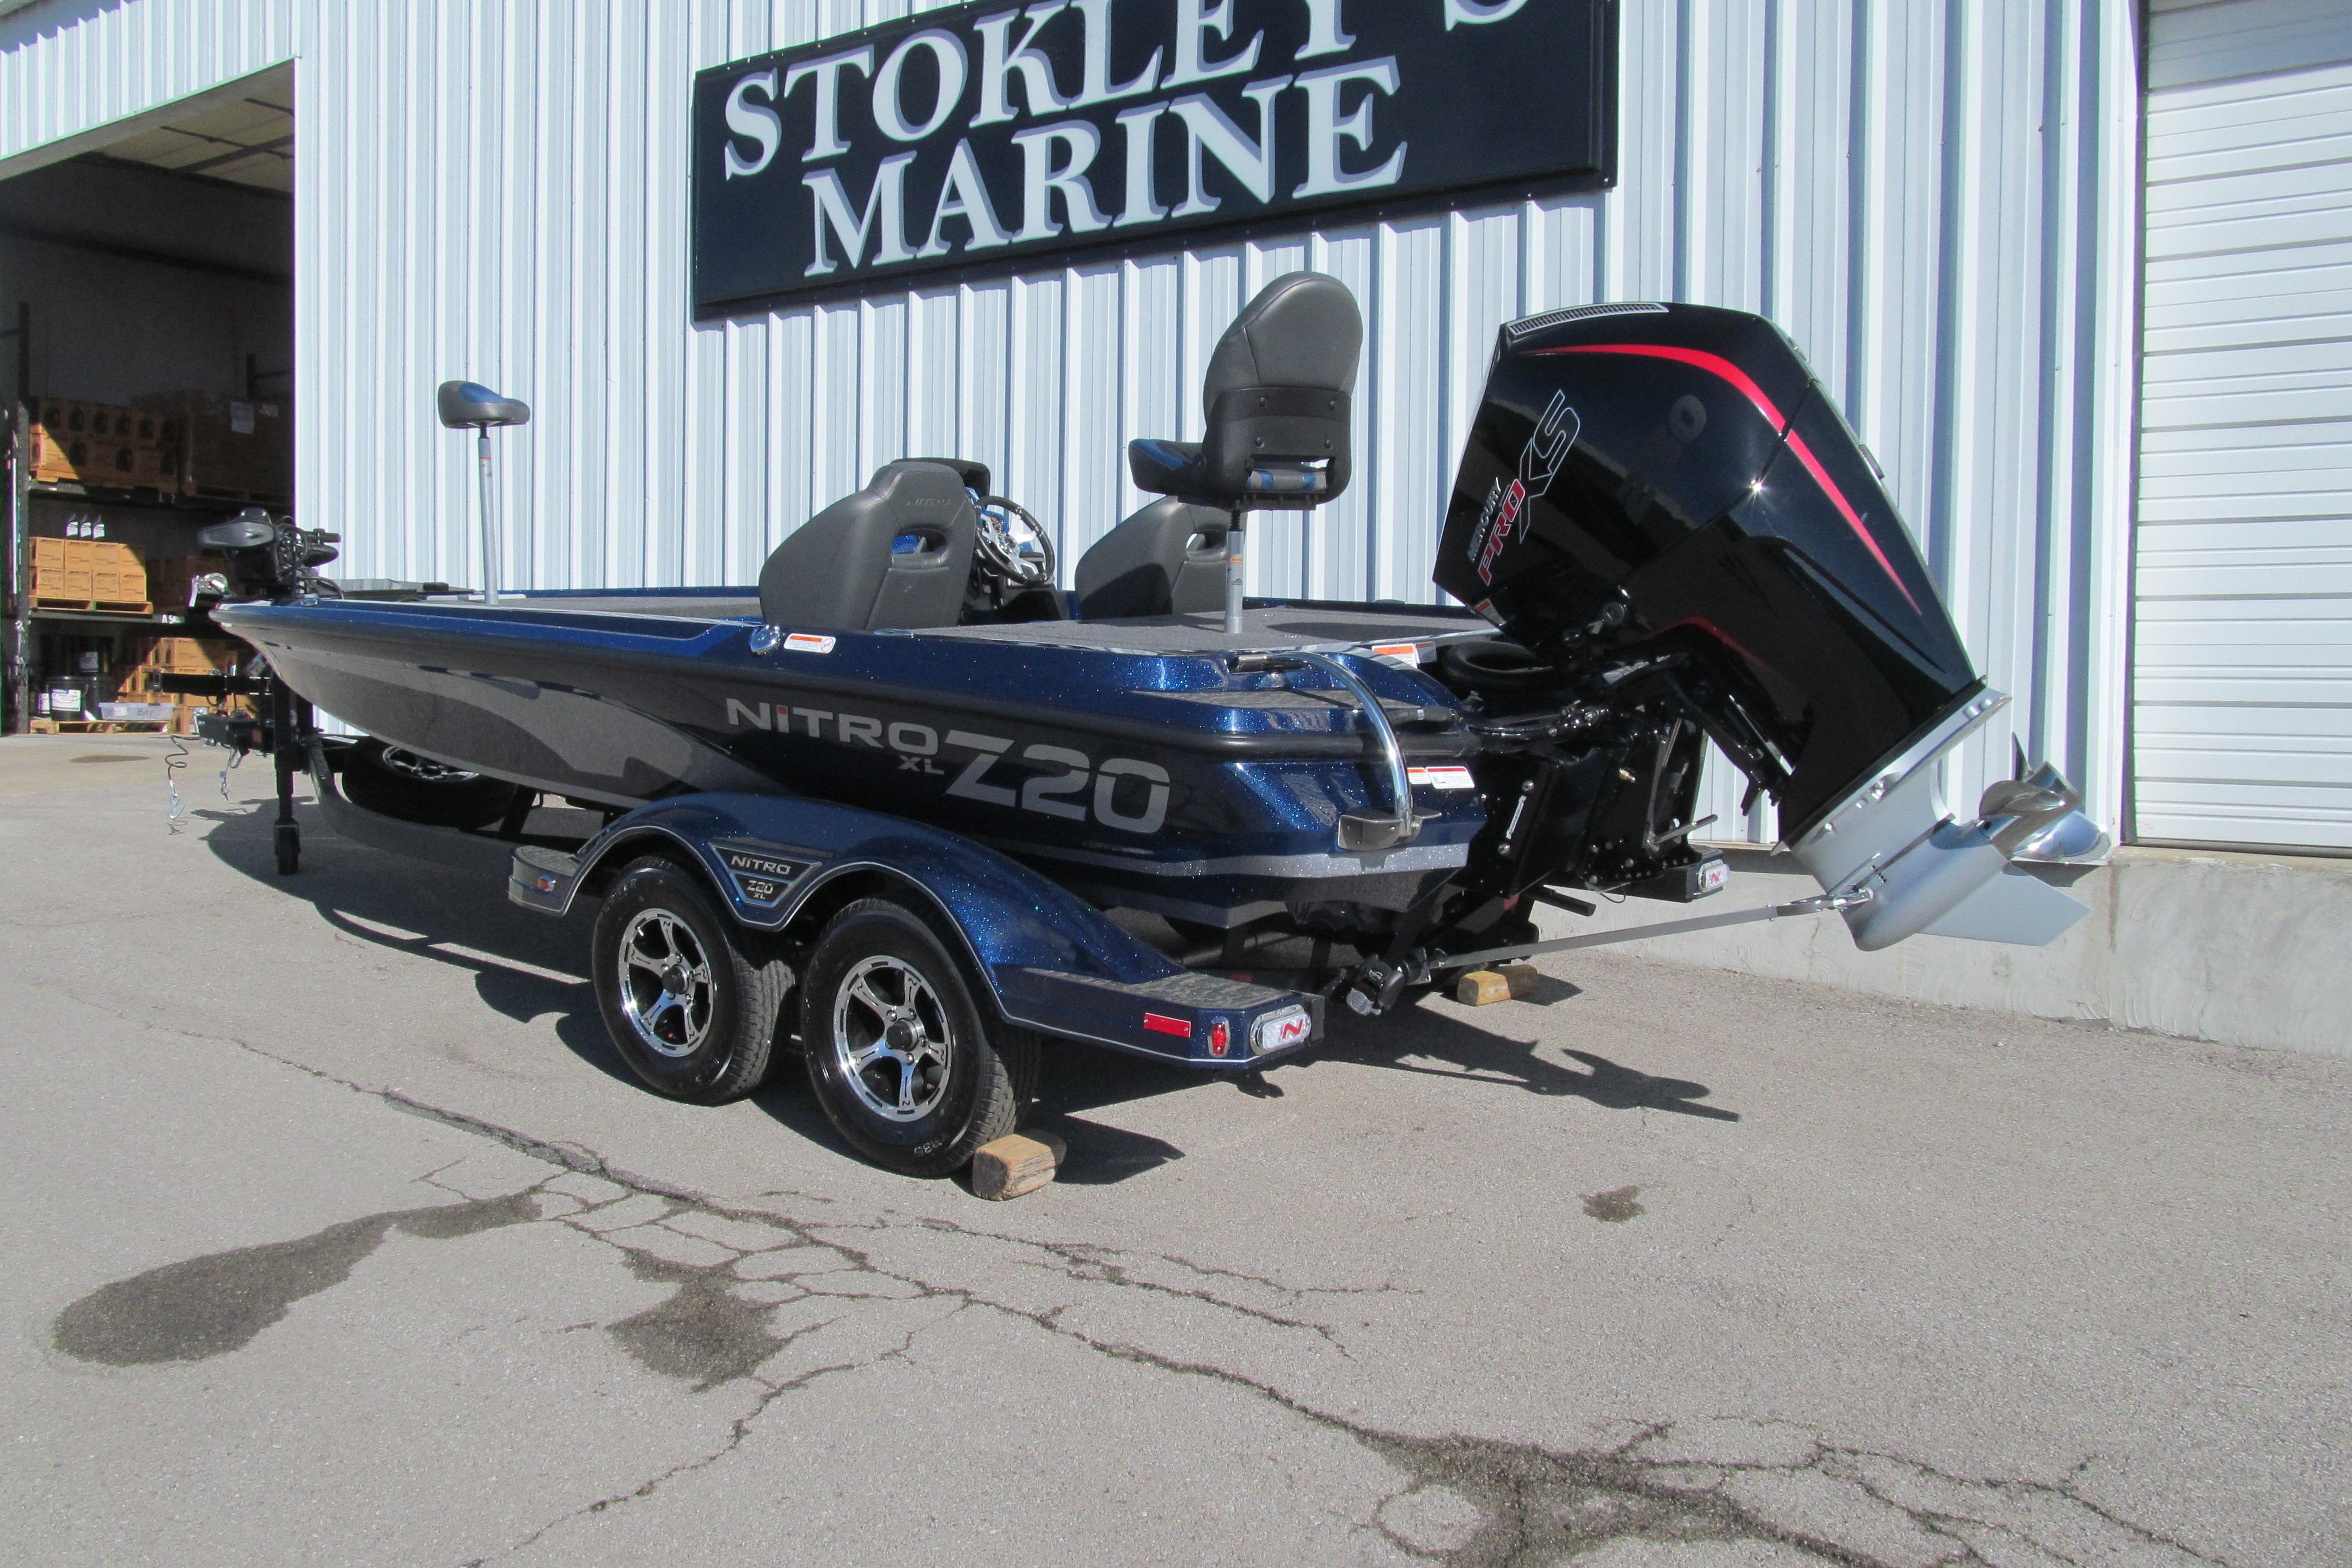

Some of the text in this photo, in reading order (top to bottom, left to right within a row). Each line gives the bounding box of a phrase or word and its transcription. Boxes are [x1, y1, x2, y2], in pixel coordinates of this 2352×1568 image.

[725, 0, 1523, 180] STOKLE
[801, 55, 1407, 277] MARINE
[1467, 477, 1502, 564] MERCURY
[1478, 478, 1526, 586] PRO
[1518, 389, 1581, 544] XS
[726, 698, 1171, 834] NITRO Z20
[897, 755, 945, 775] XL
[731, 855, 791, 875] NITRO
[746, 880, 774, 894] Z20
